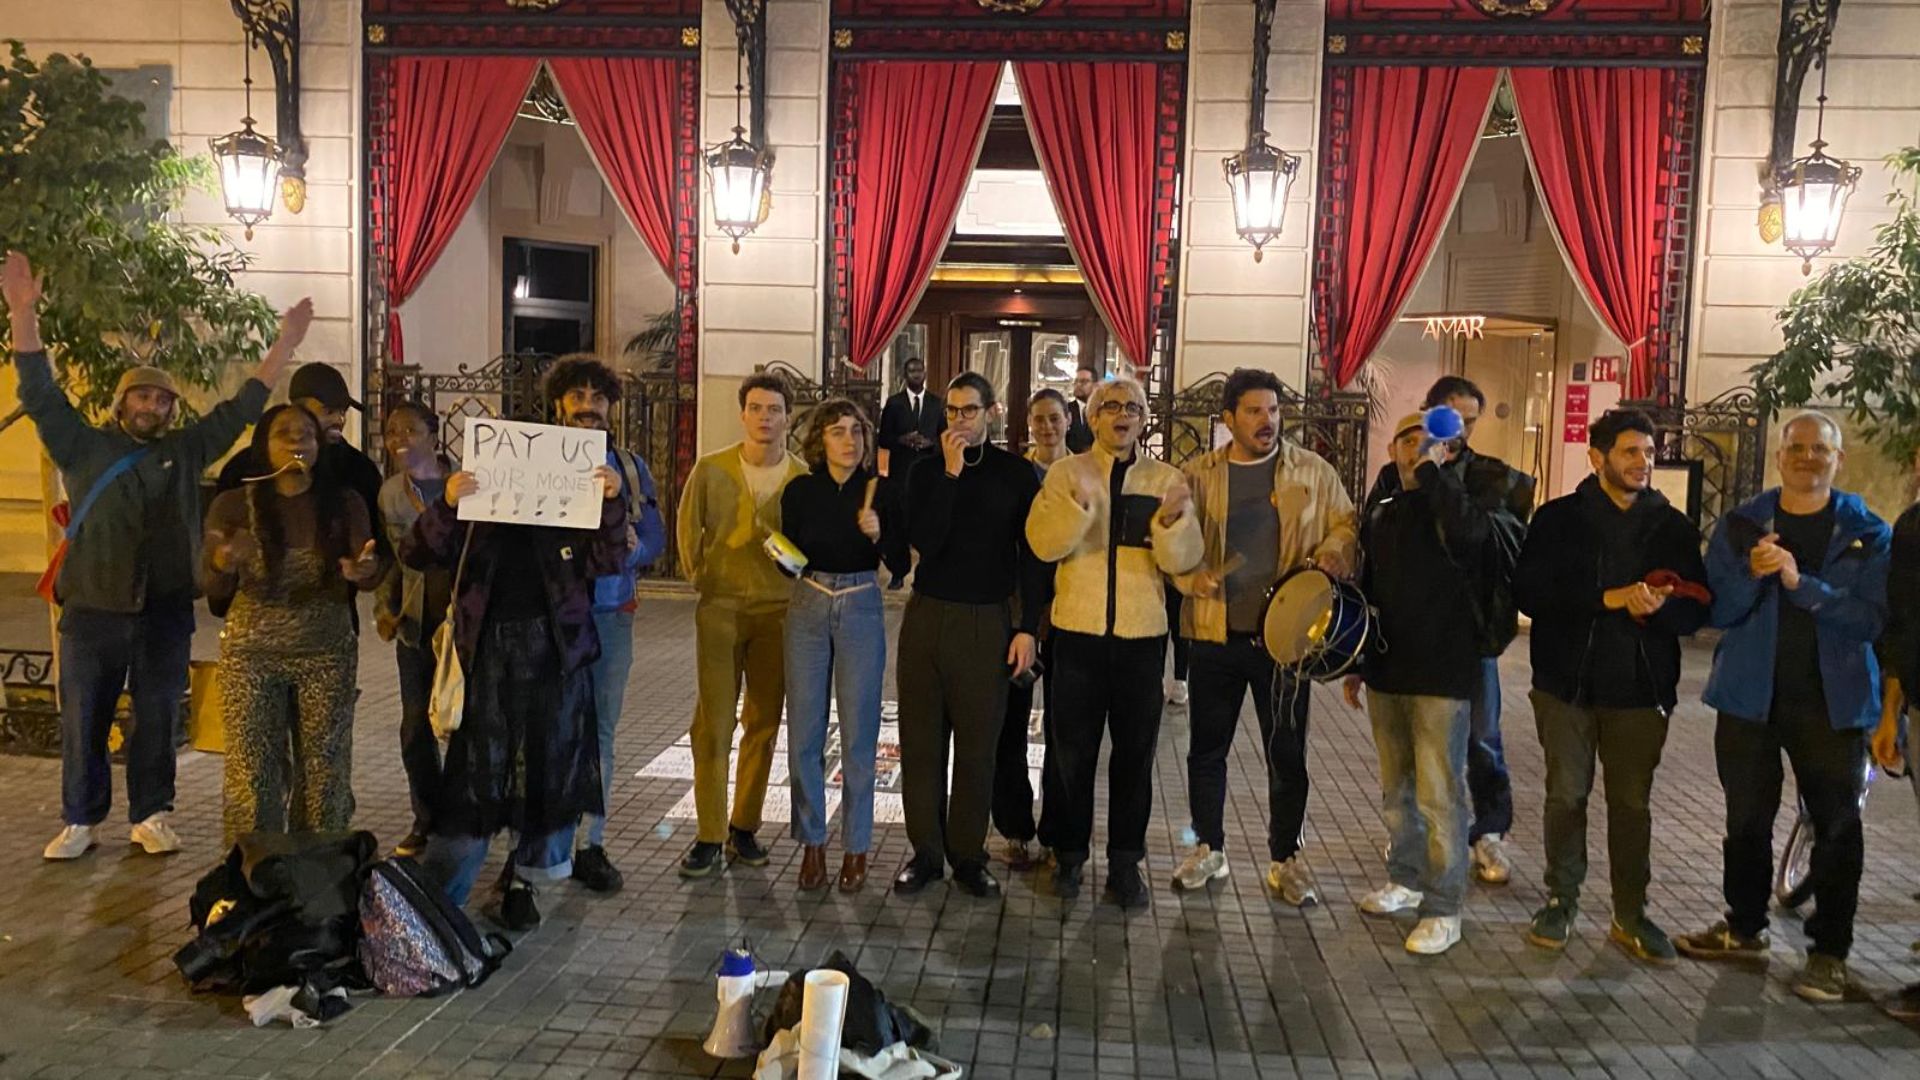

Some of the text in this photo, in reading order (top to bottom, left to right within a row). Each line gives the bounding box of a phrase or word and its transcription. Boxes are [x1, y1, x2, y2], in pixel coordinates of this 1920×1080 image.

[1421, 316, 1486, 341] AMAR
[474, 423, 595, 473] PAY US
[474, 466, 525, 491] OUR
